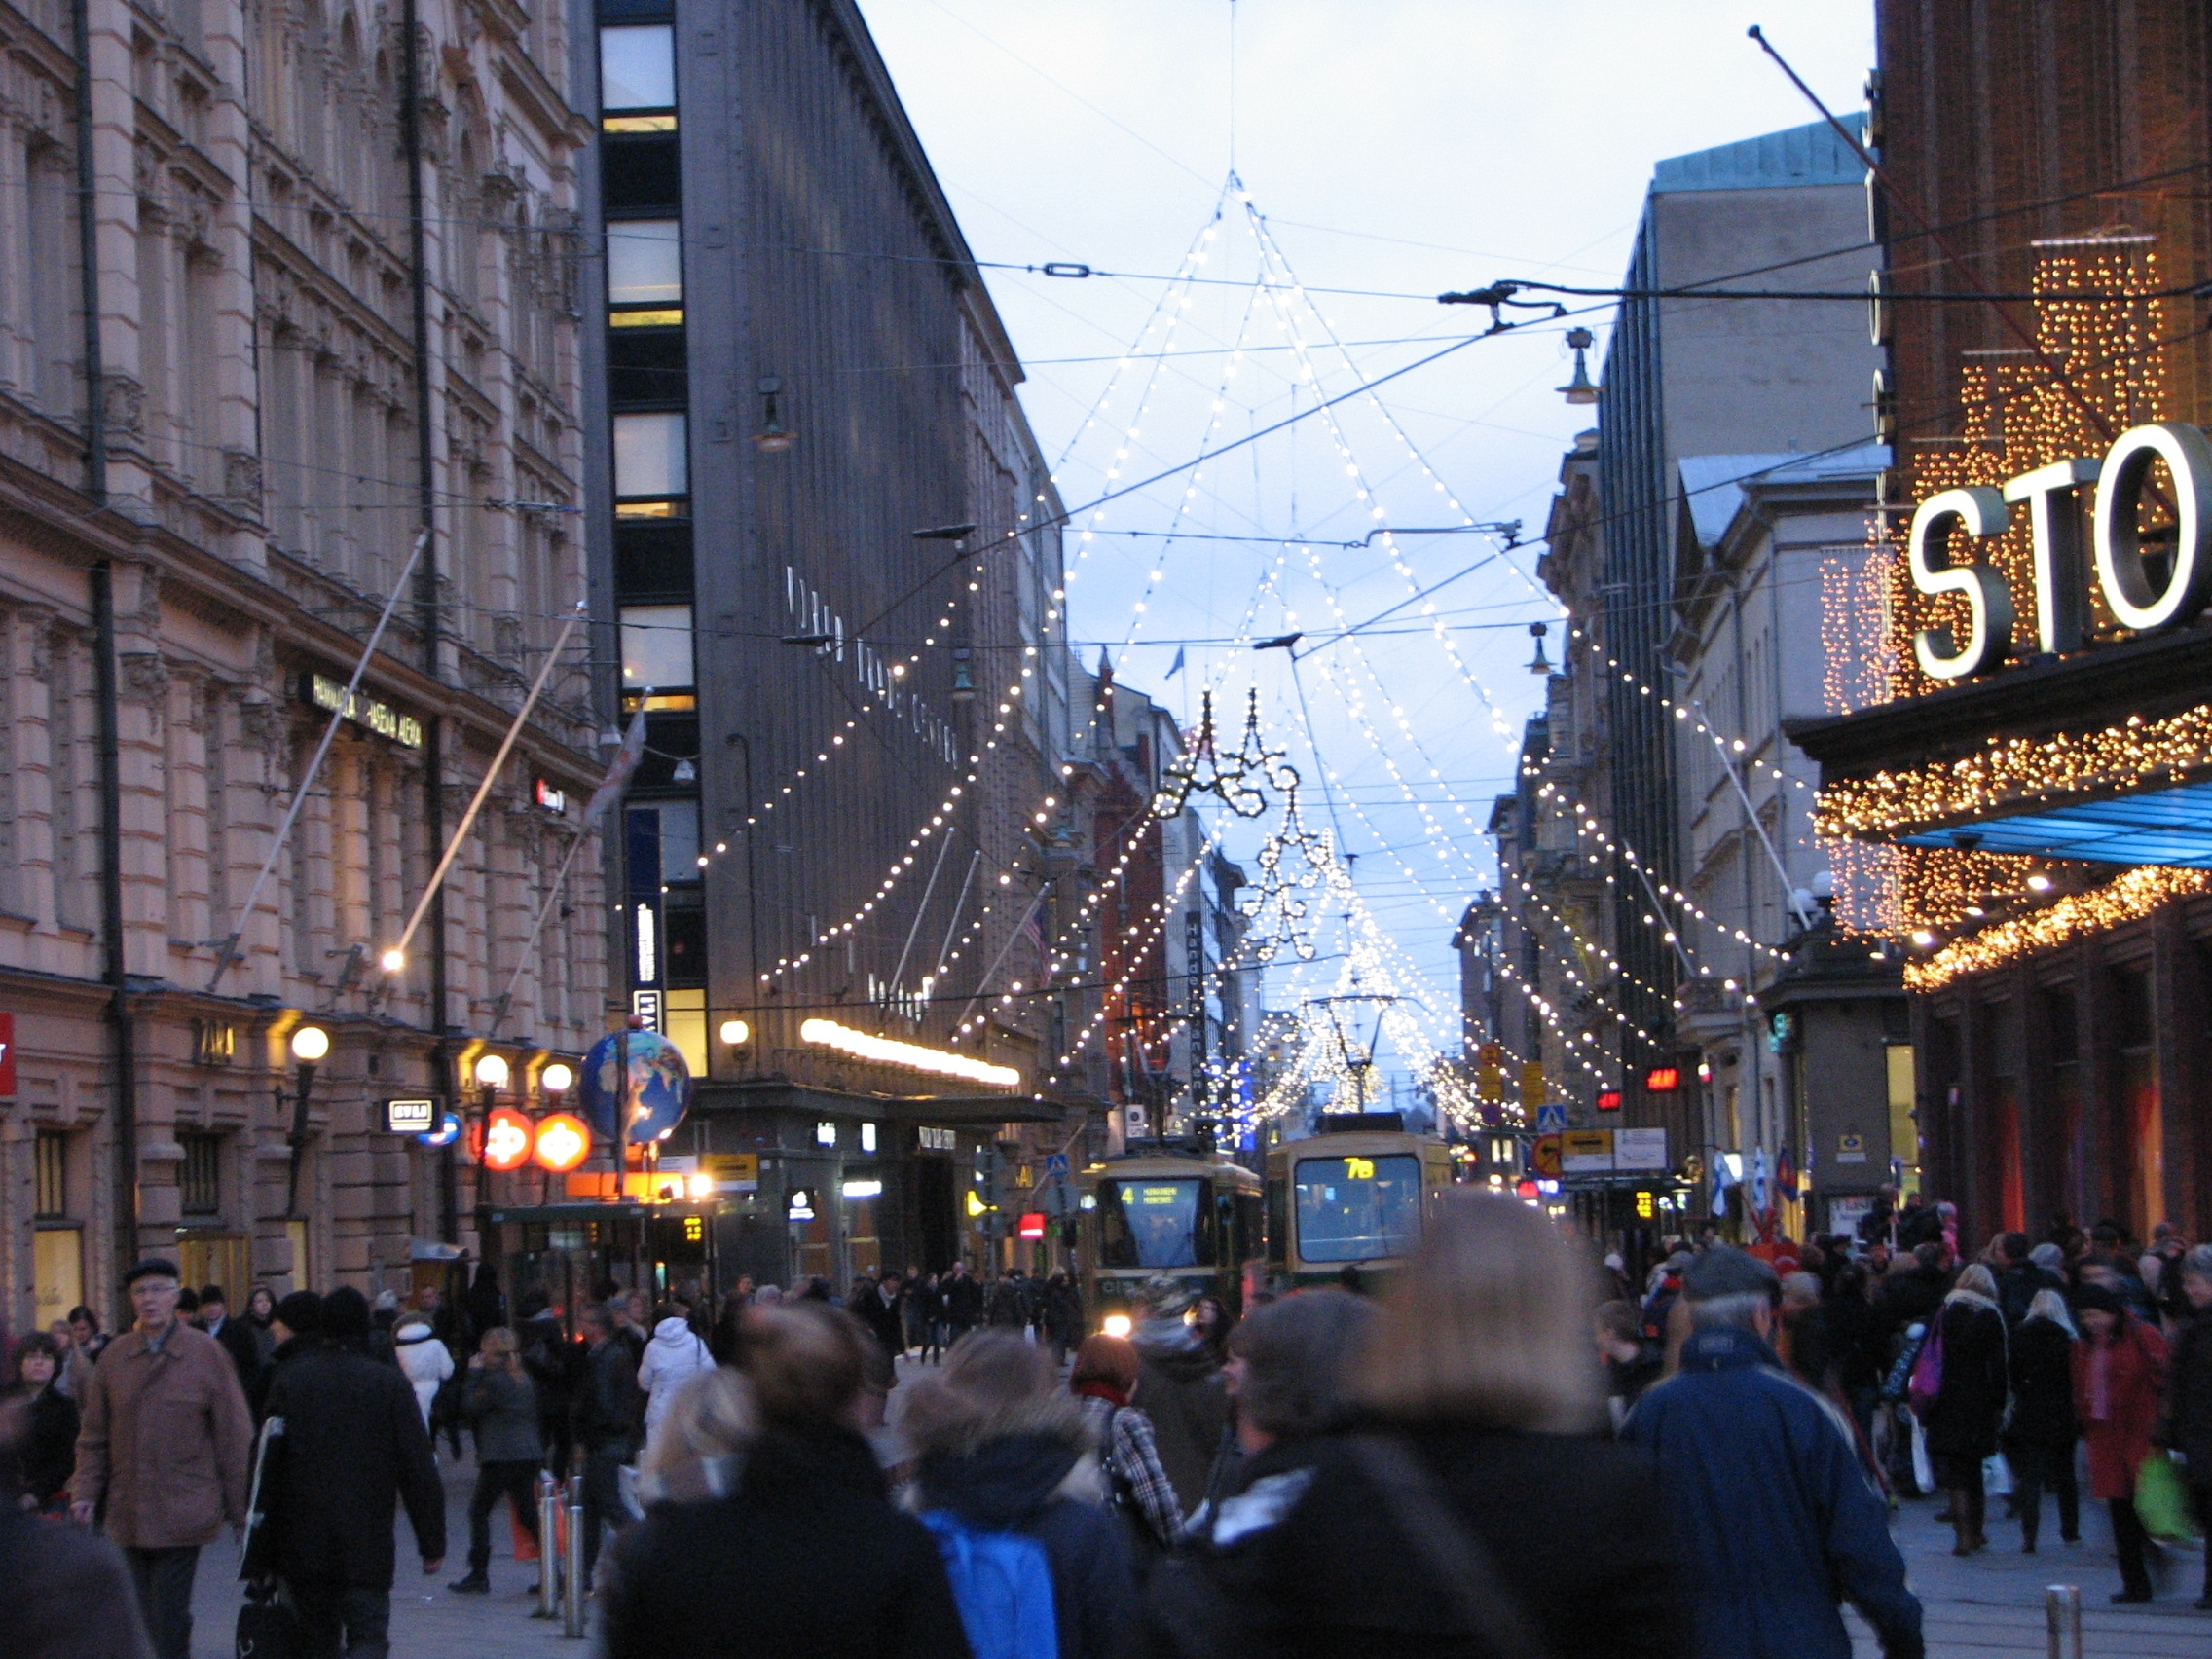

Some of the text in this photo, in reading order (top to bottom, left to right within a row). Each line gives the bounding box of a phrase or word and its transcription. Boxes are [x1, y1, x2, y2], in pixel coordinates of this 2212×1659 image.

[1908, 423, 2200, 680] STO
[1344, 1158, 1374, 1179] 7B
[1121, 1187, 1134, 1204] 4
